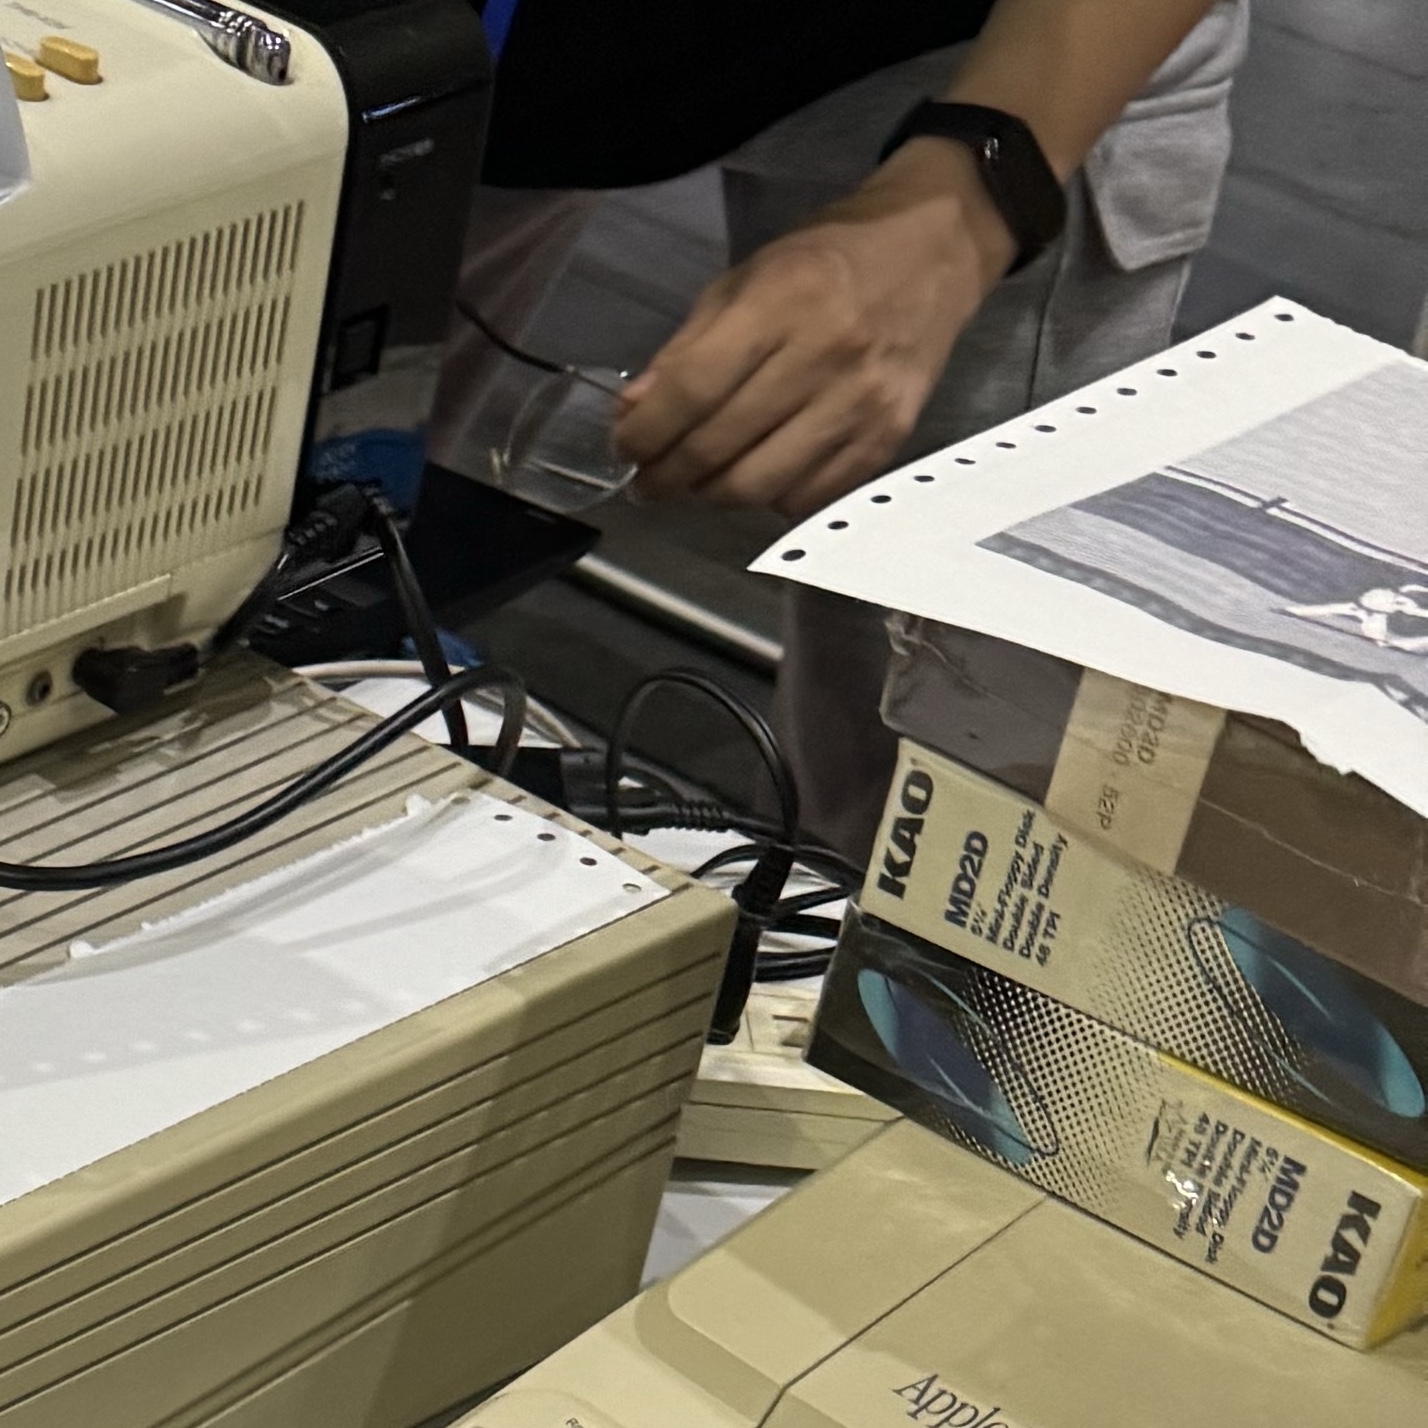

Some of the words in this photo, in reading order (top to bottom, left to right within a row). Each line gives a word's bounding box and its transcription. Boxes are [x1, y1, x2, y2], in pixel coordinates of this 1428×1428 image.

[877, 769, 935, 900] KAO
[944, 830, 989, 929] MD2D
[1003, 893, 1028, 953] Double
[1021, 841, 1044, 891] Sided
[1019, 901, 1045, 959] Double
[1038, 832, 1069, 899] Density
[1213, 1127, 1246, 1188] Double
[1251, 1155, 1307, 1254] MD2D
[1309, 1190, 1382, 1319] KAO
